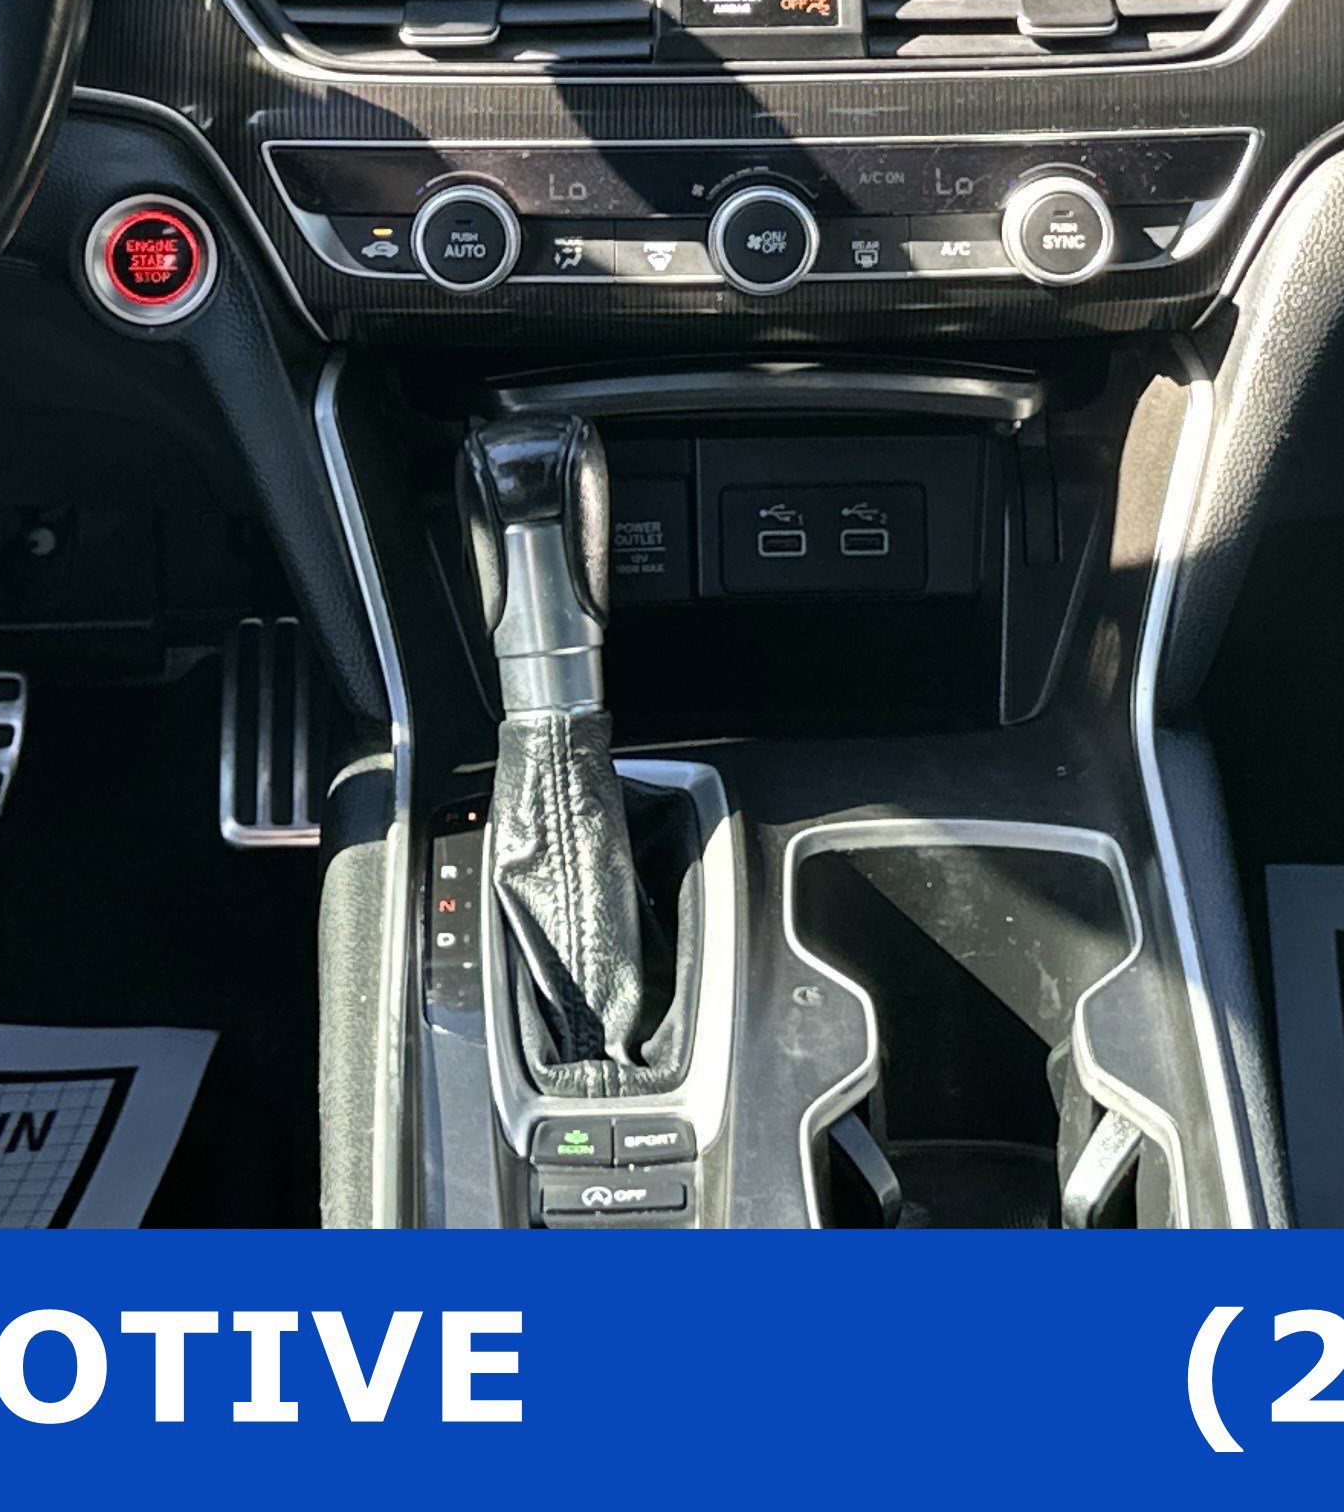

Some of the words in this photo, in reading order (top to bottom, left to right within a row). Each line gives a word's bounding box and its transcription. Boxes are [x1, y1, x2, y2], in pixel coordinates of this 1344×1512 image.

[885, 171, 905, 184] ON
[450, 231, 479, 243] PUSH
[1041, 233, 1087, 251] SYNC
[125, 238, 180, 253] ENGINE
[443, 243, 488, 259] AUTO
[761, 242, 787, 255] OFF
[940, 241, 971, 257] A/C
[133, 270, 172, 284] STOP
[614, 533, 663, 546] OUTLET
[439, 899, 456, 913] N
[624, 1132, 677, 1148] SPORT
[613, 1188, 647, 1202] OFF
